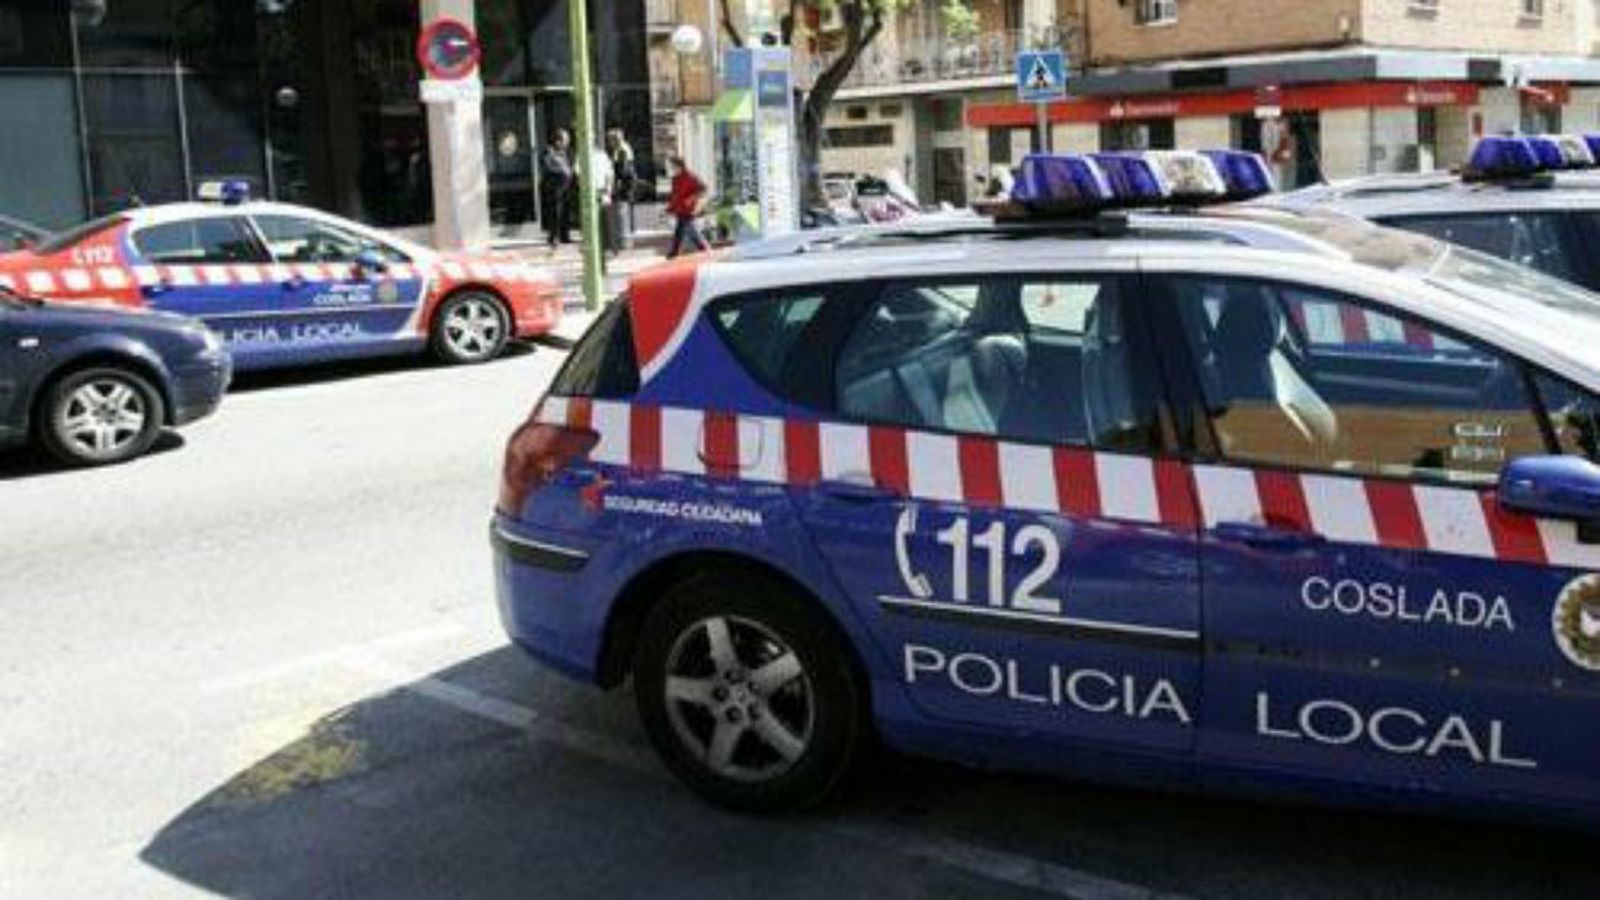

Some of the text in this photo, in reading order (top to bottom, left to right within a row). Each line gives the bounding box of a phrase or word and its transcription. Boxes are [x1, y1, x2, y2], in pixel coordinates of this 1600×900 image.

[290, 321, 361, 342] LOCAL
[936, 516, 1061, 613] 112
[1302, 576, 1514, 632] COSLADA
[904, 643, 1537, 767] POLICIA LOCAL
